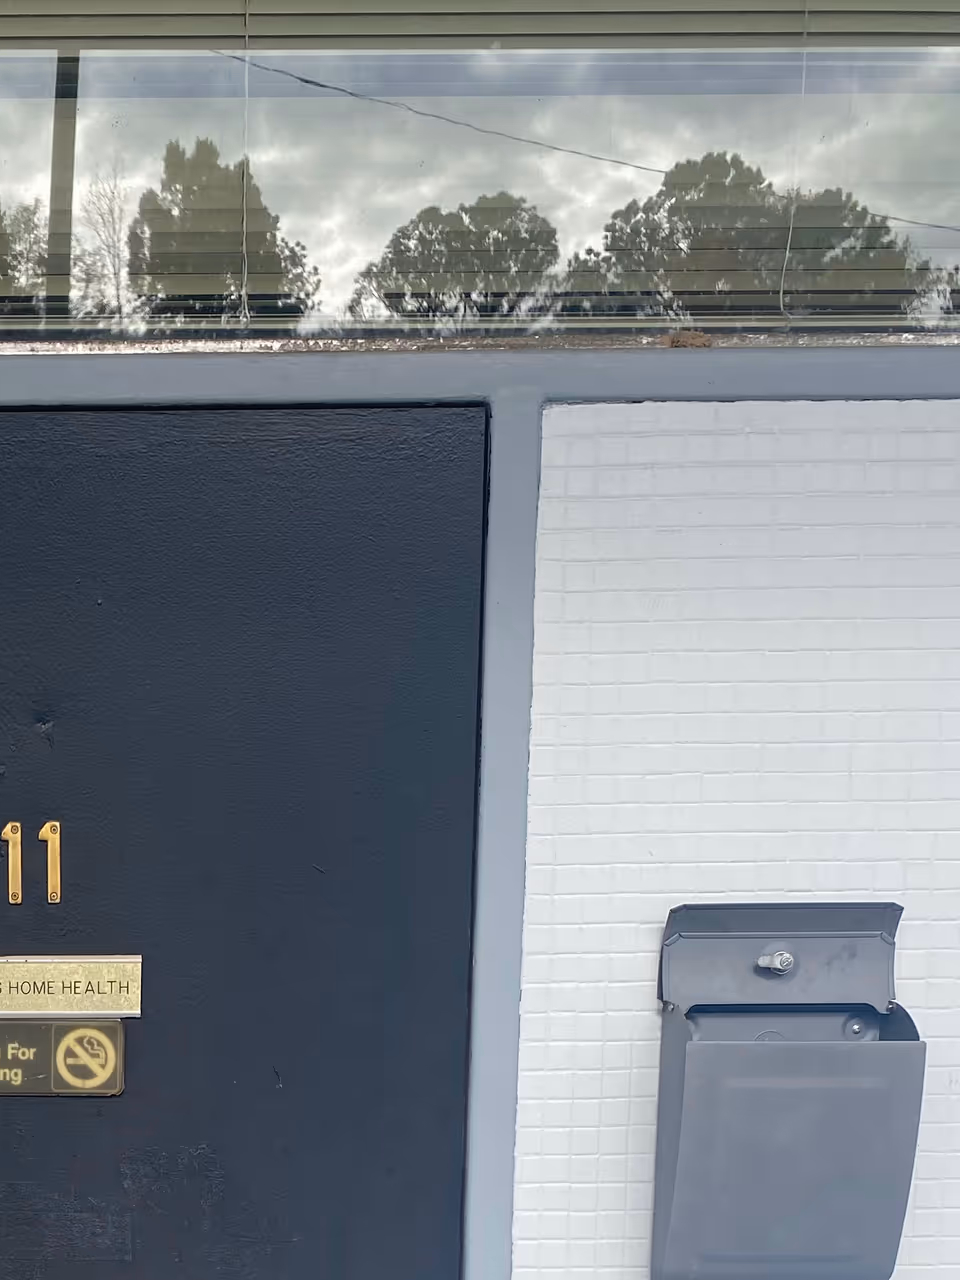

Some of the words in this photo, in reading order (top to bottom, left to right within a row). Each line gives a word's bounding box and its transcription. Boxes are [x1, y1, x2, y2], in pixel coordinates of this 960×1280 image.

[1, 821, 61, 904] 11
[9, 981, 55, 995] HOME
[62, 981, 130, 995] HEALTH
[7, 1043, 36, 1060] For
